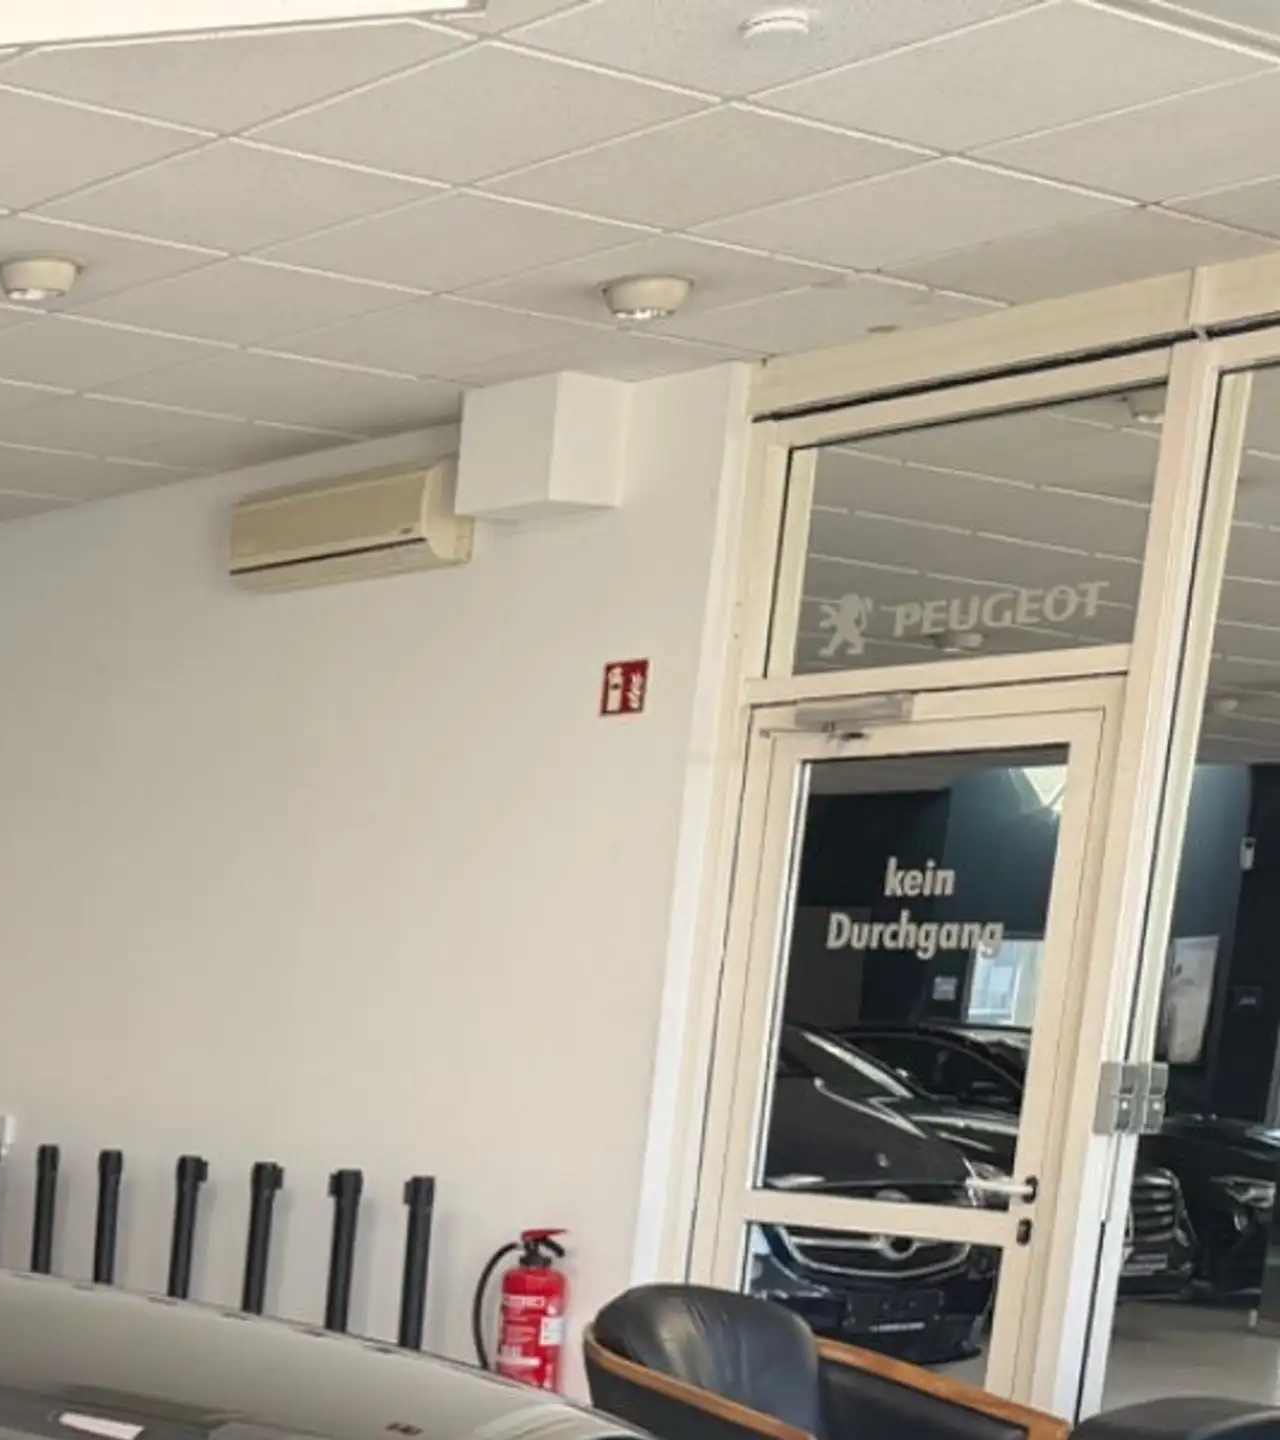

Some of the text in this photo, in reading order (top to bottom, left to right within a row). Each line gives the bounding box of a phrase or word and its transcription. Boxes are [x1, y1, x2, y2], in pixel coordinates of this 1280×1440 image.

[887, 581, 1110, 638] PEUGEOT
[883, 855, 956, 897] kein
[825, 908, 1004, 960] Durchgang
